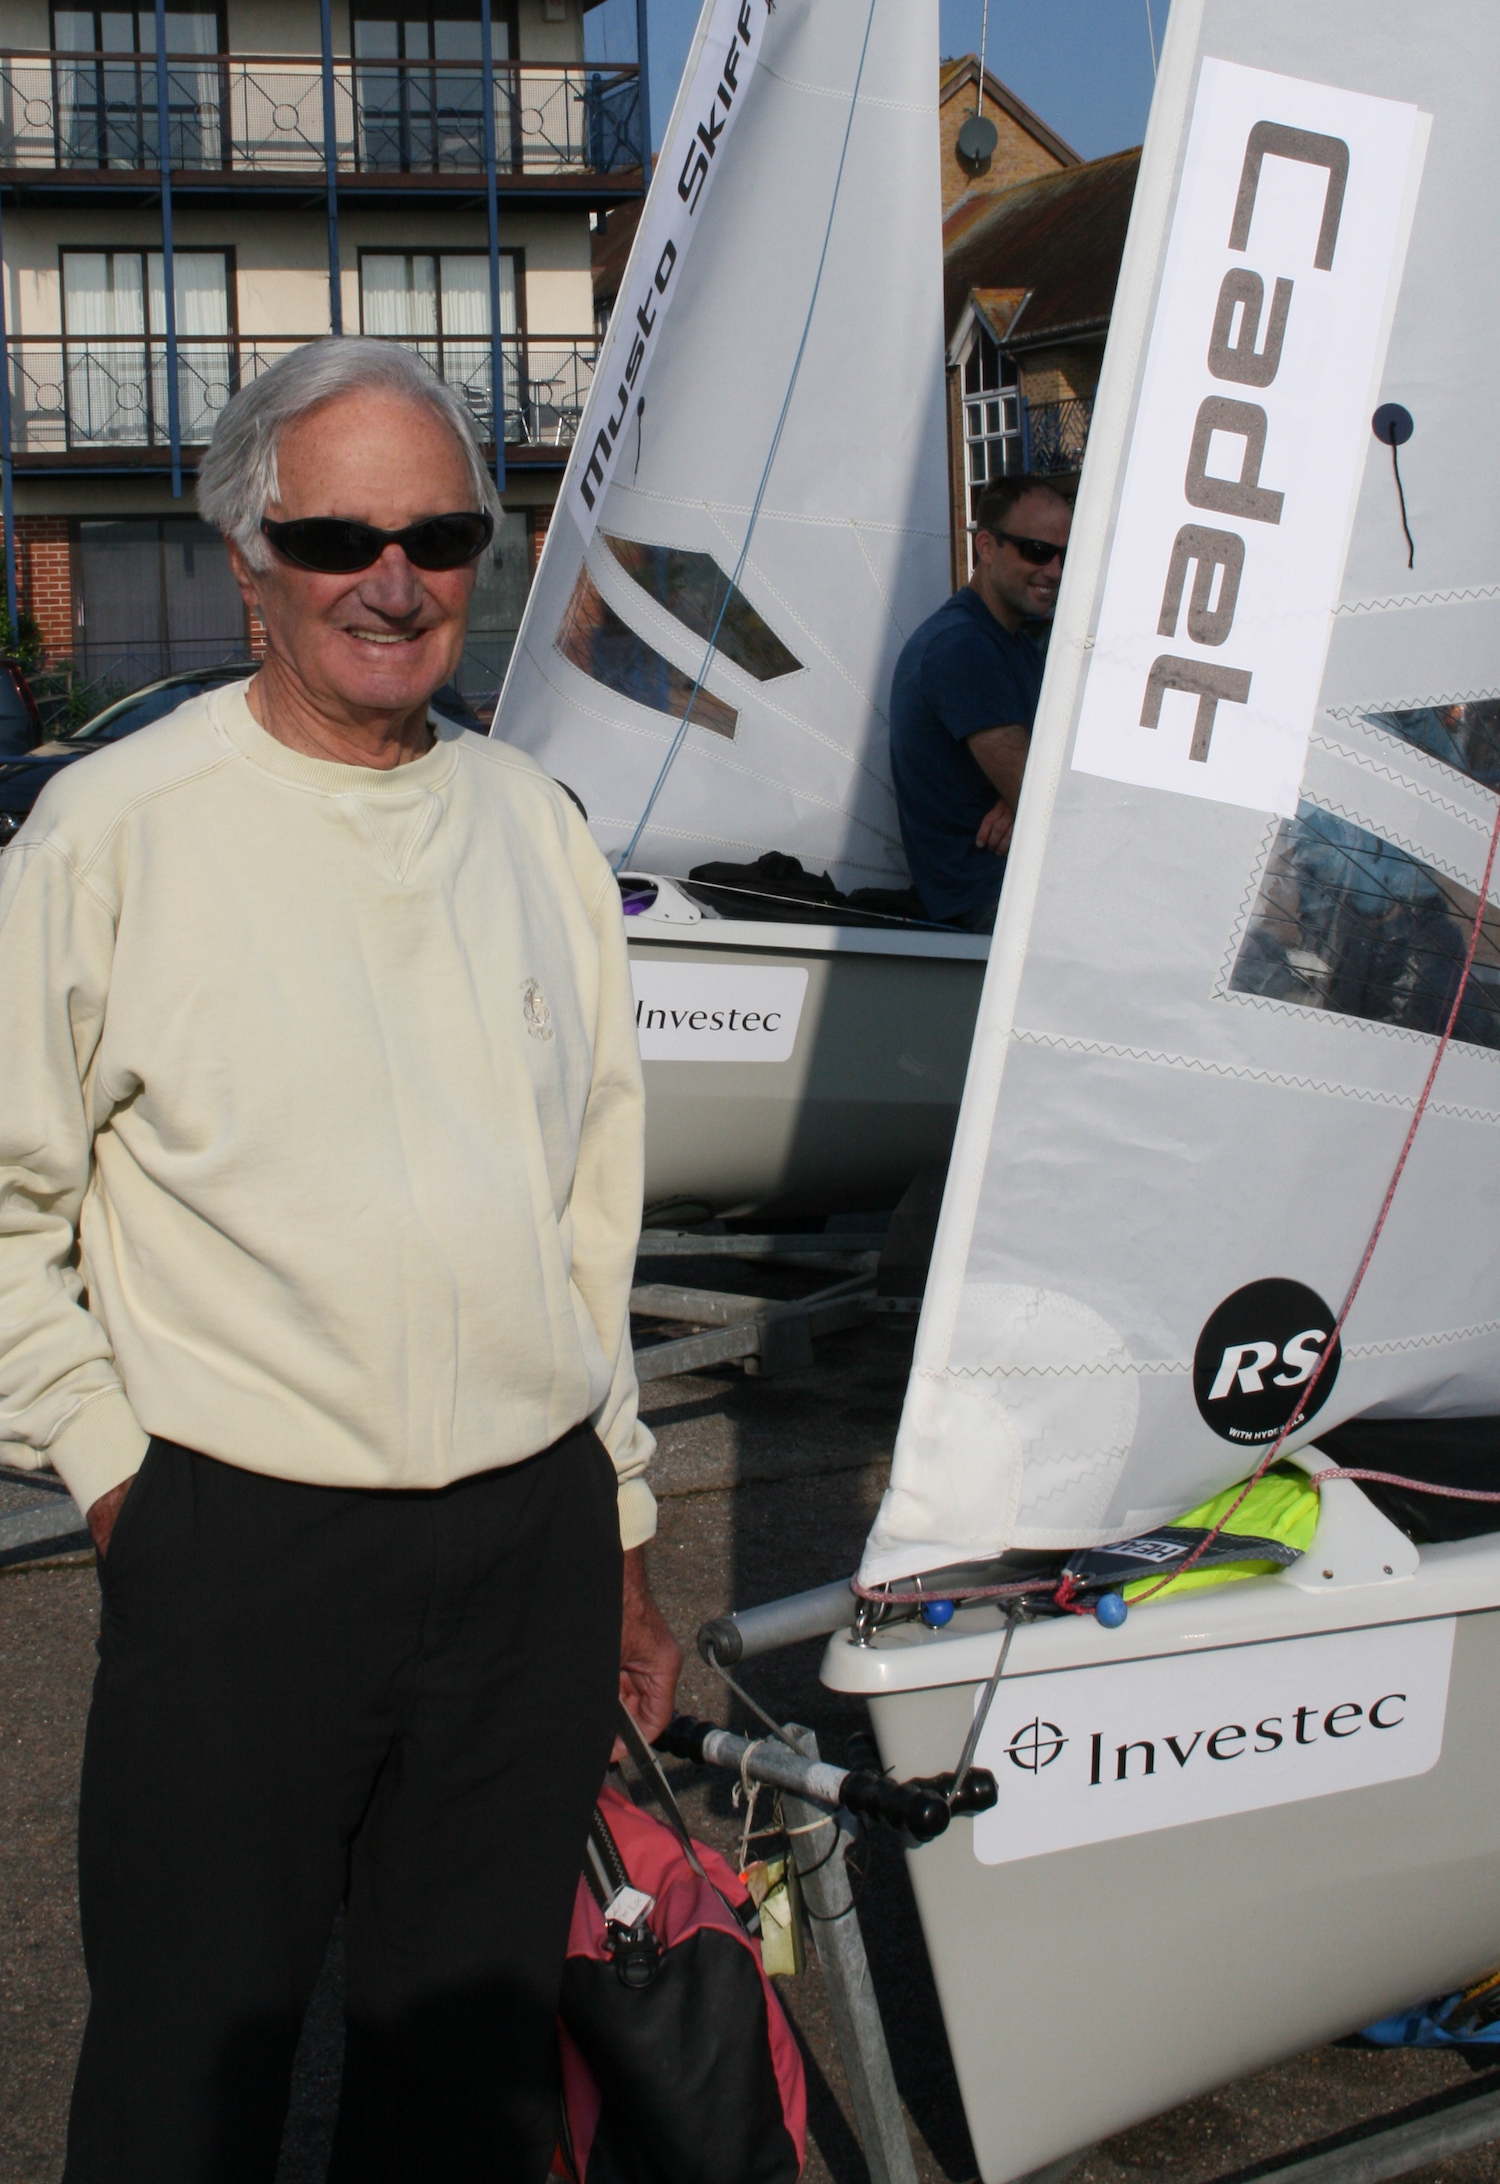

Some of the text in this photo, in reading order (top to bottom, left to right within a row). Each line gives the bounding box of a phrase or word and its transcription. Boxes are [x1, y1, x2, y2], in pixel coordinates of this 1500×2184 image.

[1139, 119, 1350, 763] Cadet
[635, 1000, 781, 1032] Investec
[1207, 1329, 1327, 1400] RS
[1229, 1427, 1253, 1440] WITH
[1088, 1693, 1407, 1786] Investec
